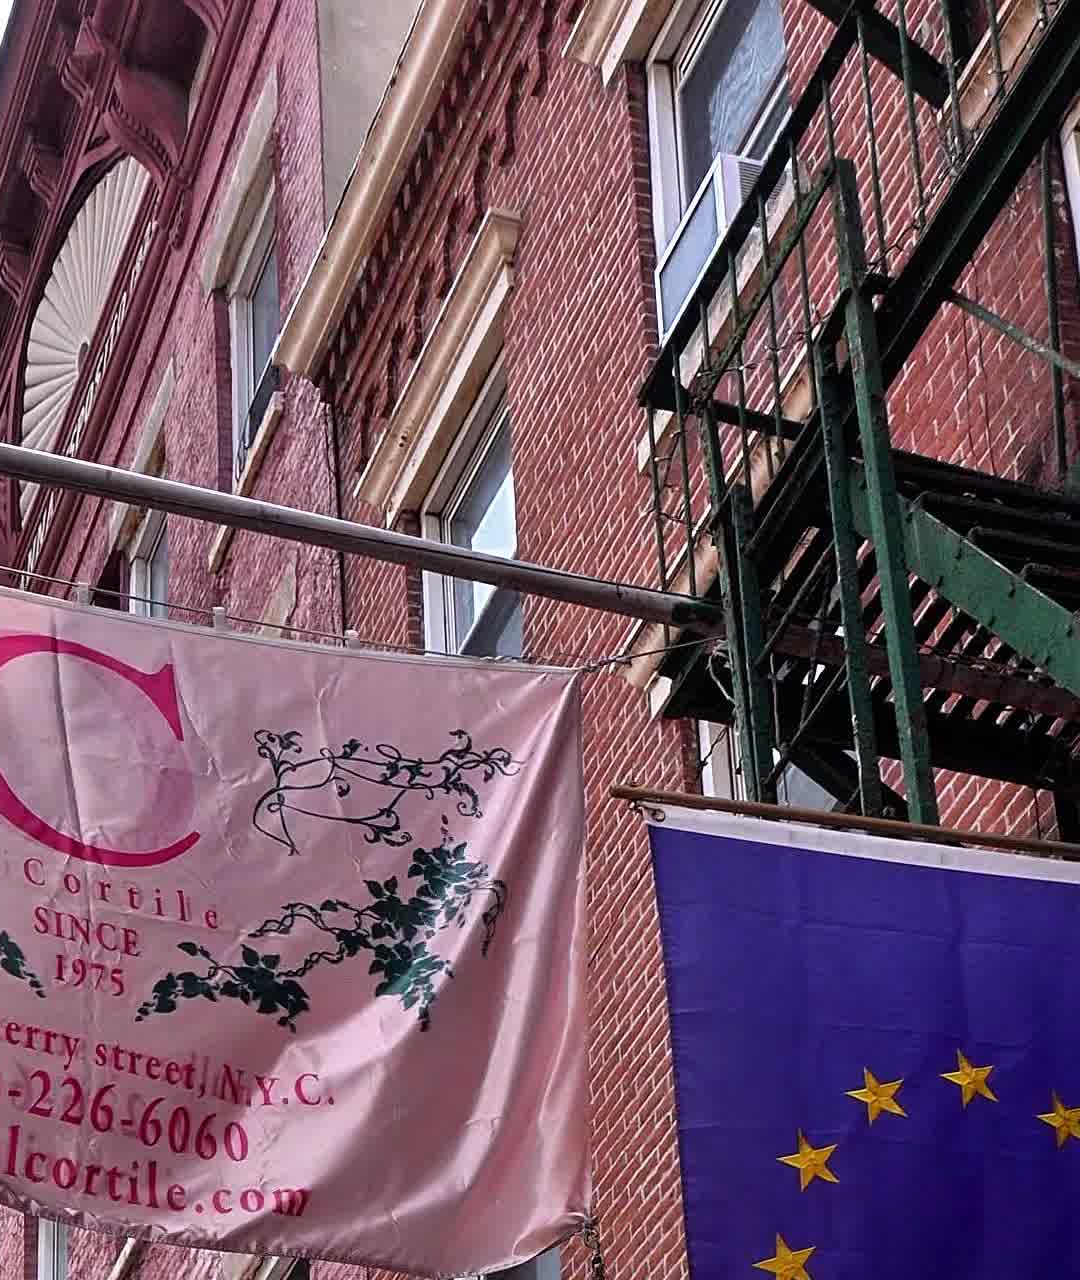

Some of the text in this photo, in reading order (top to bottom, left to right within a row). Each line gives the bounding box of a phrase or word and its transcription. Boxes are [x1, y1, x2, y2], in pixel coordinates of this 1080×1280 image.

[23, 857, 219, 930] Cortile
[32, 905, 142, 958] SINCE
[55, 953, 125, 997] 1975
